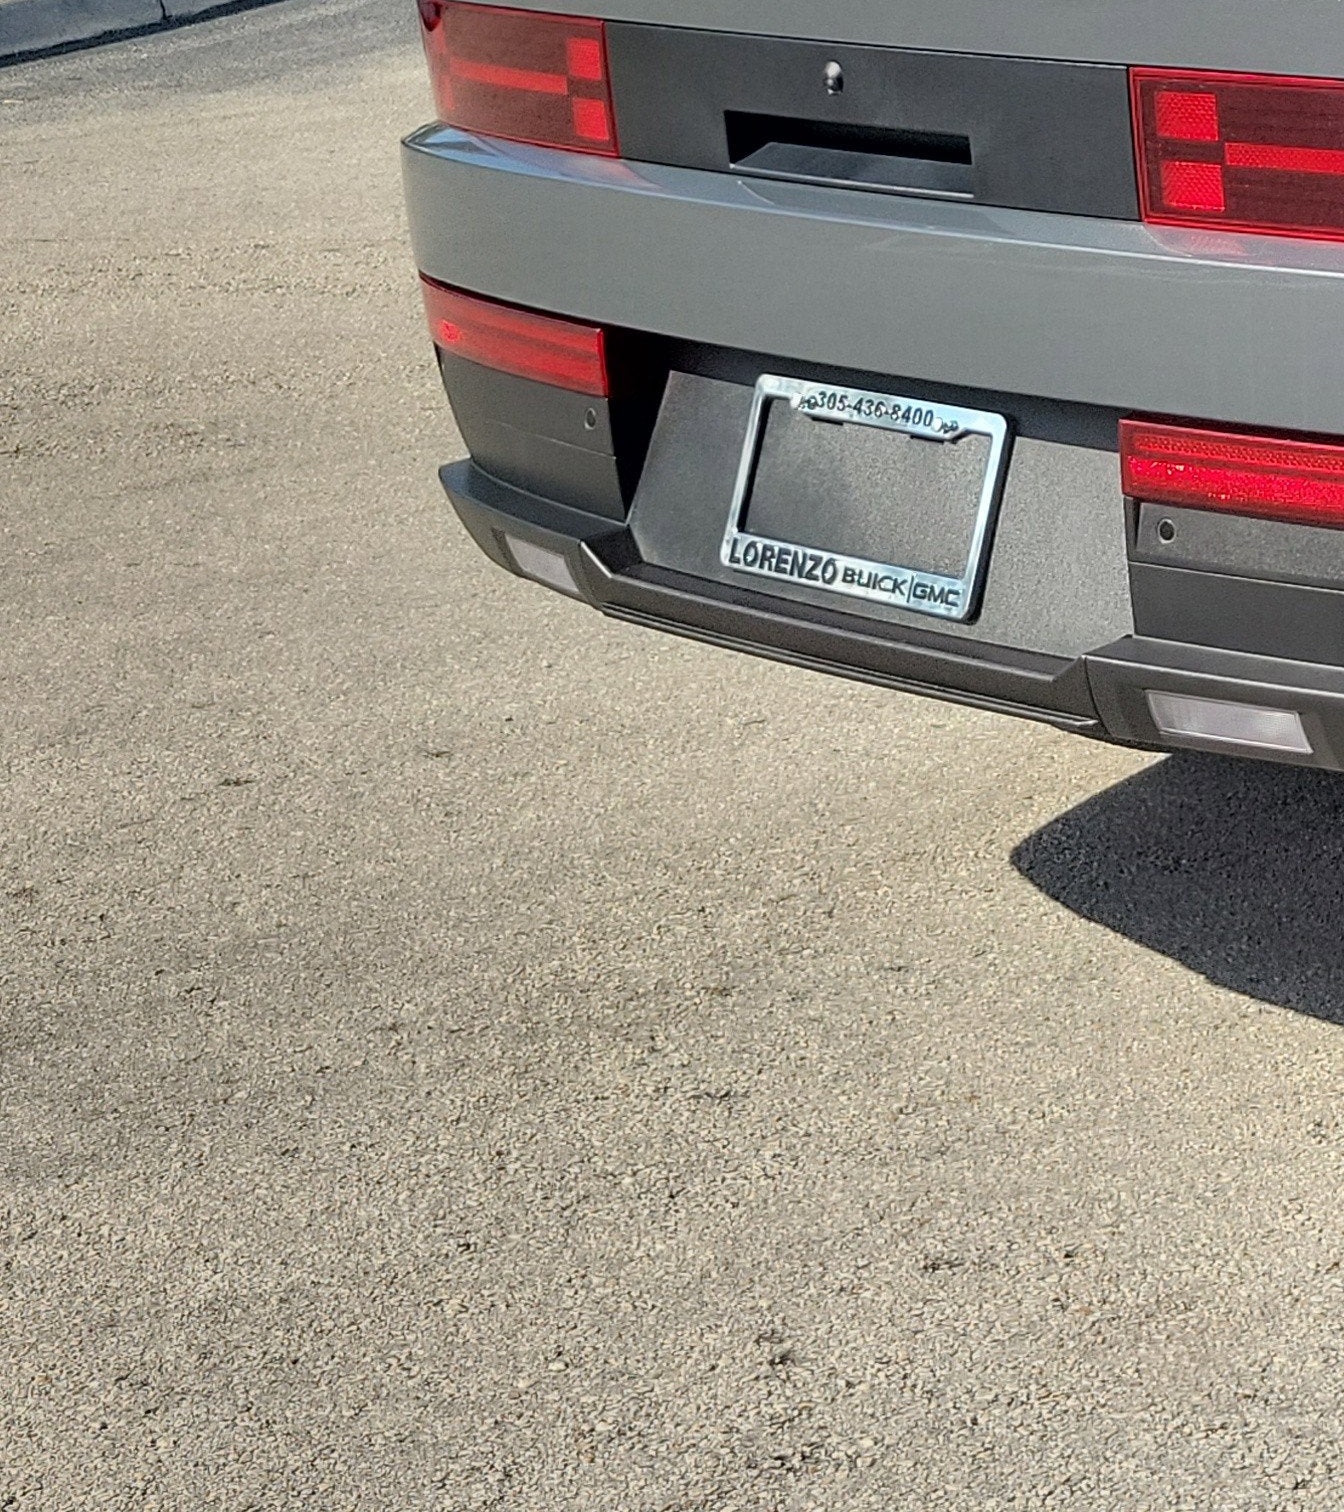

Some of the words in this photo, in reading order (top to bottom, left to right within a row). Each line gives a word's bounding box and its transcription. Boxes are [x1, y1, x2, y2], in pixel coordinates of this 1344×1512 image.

[816, 390, 934, 428] 305-436-8400
[728, 536, 838, 586] LORENZO
[841, 566, 906, 597] BUICK
[912, 581, 961, 607] GMC
